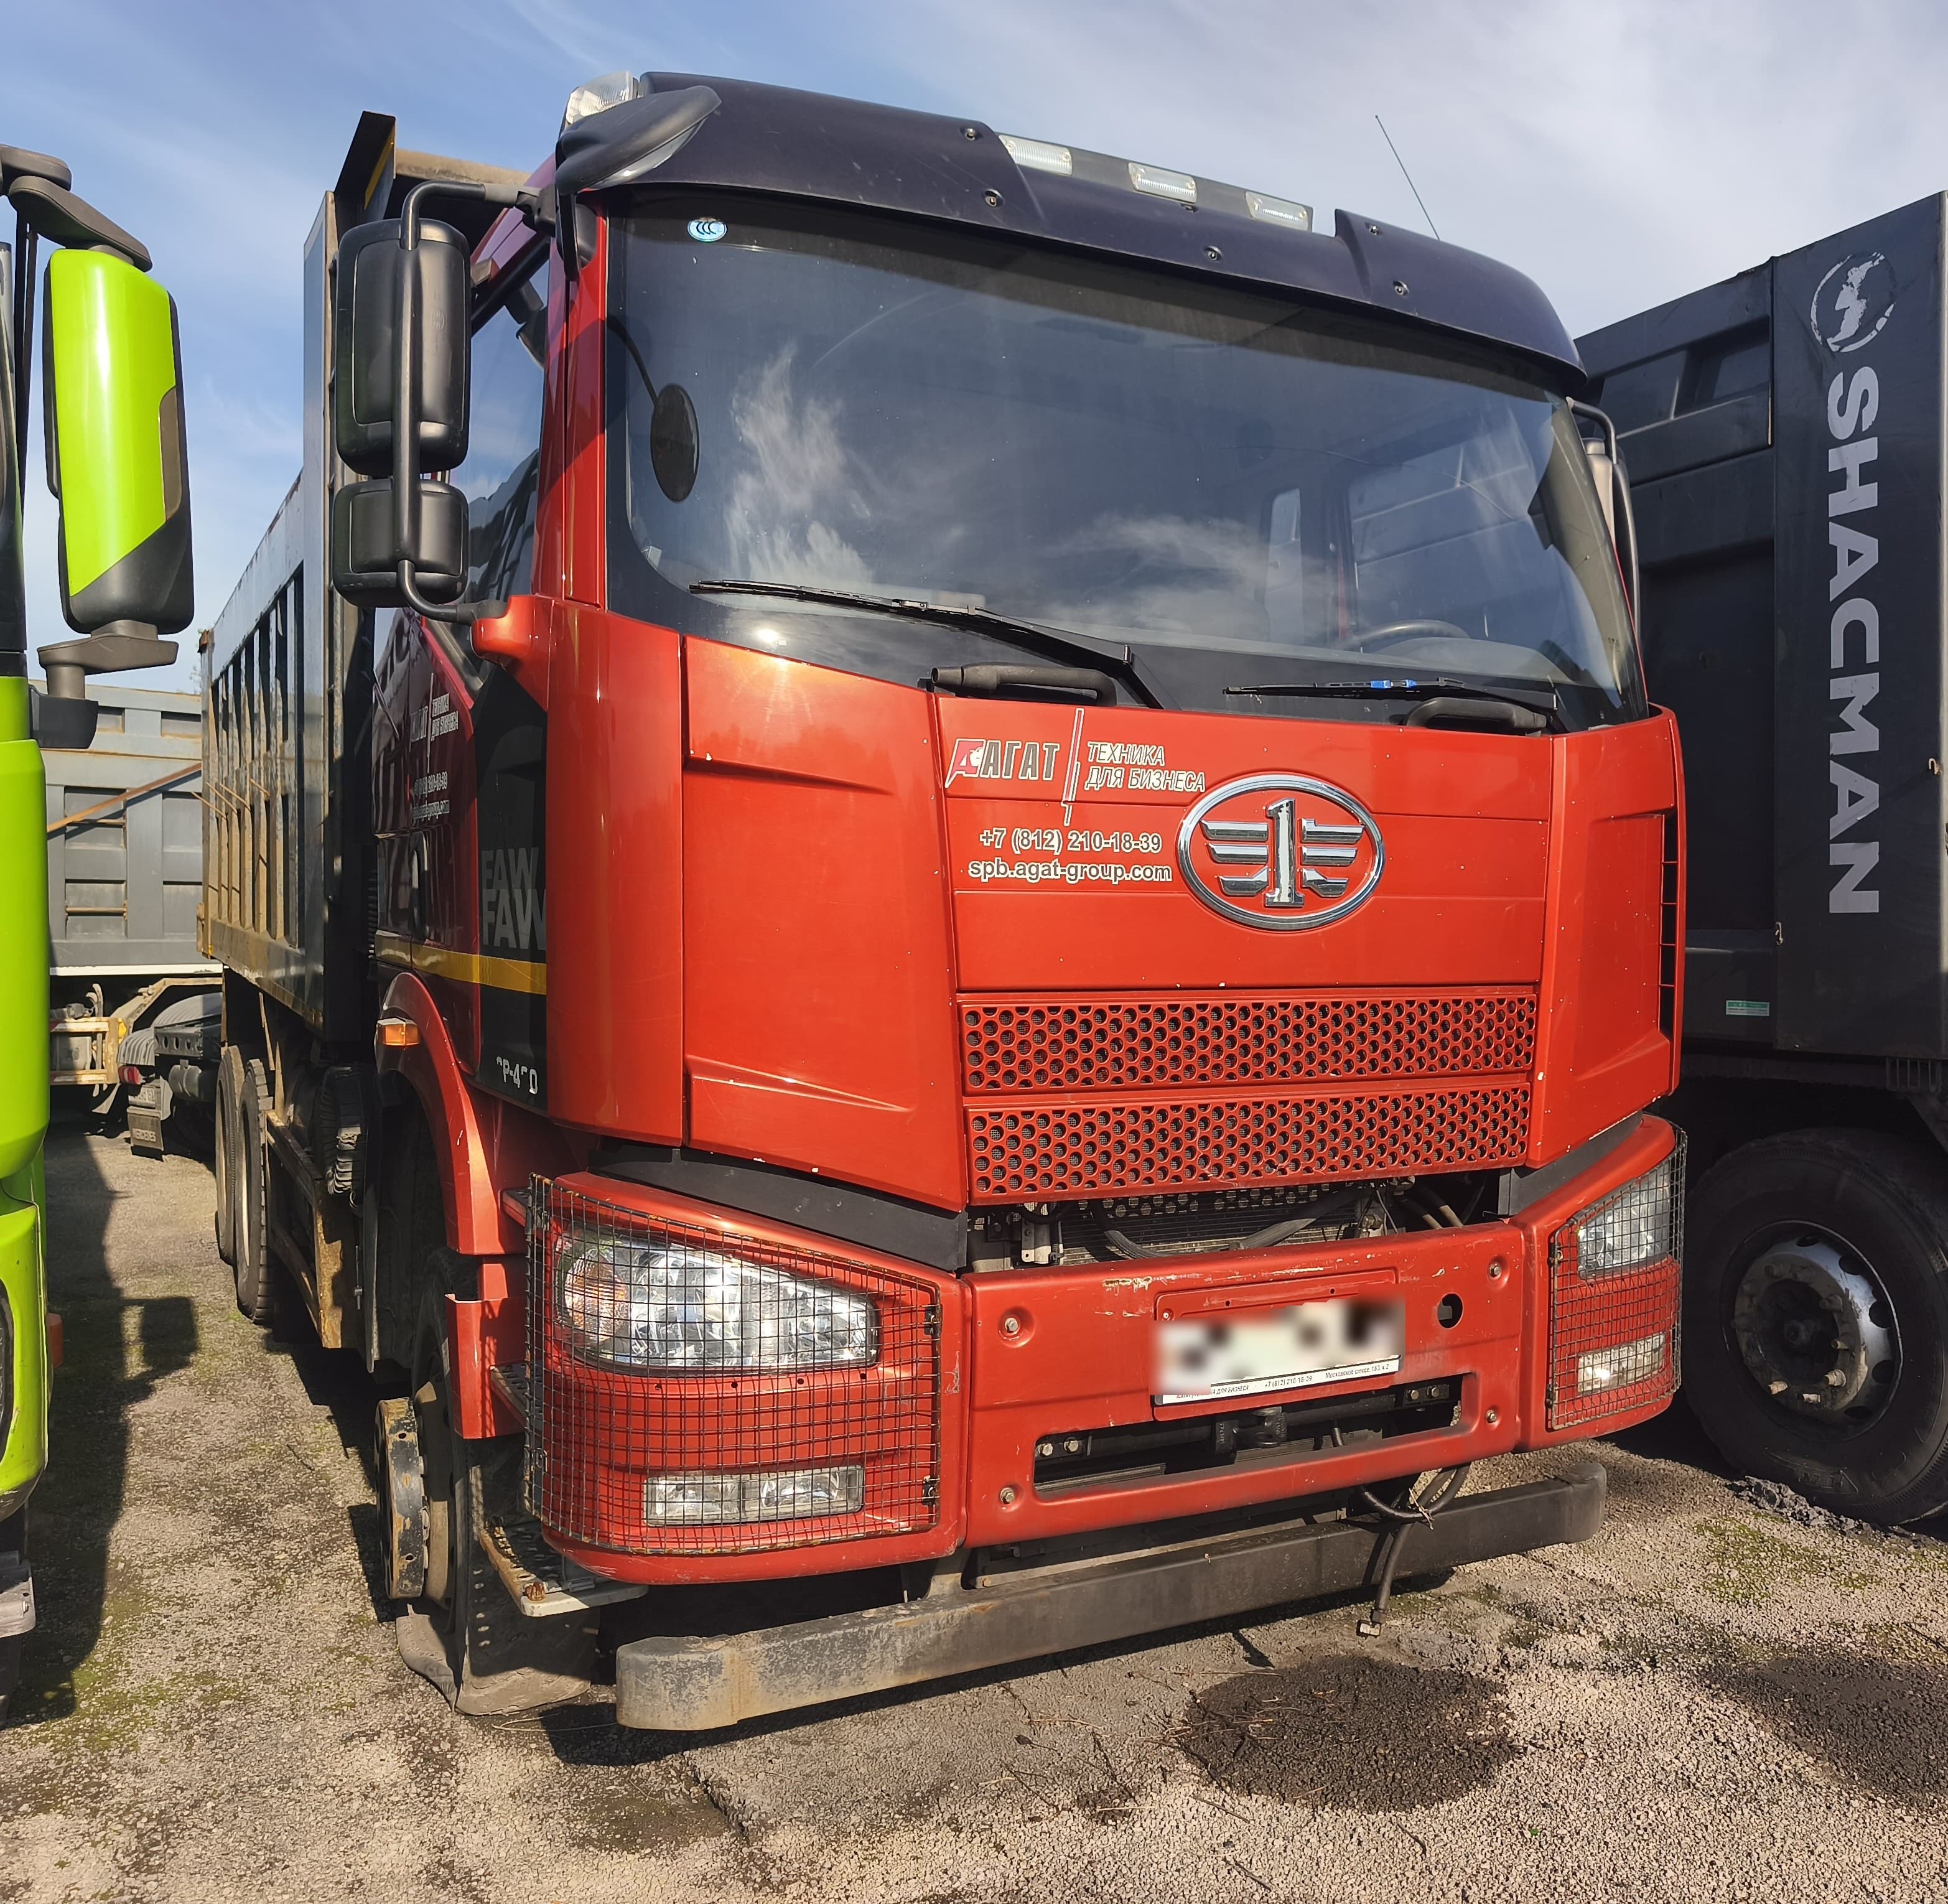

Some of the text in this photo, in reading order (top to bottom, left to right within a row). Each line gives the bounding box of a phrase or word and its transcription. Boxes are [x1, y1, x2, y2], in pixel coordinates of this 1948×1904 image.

[1827, 365, 1880, 913] SHACMAN
[979, 740, 1060, 781] АГАТ
[1087, 741, 1165, 767] ТЕХНИКА
[1084, 767, 1206, 792] ДЛЯ БИЗНЕСА
[979, 828, 1162, 854] +7 (812) 210-18-39
[482, 847, 539, 890] FAW
[969, 857, 1172, 884] spb.agat-group.com
[482, 889, 546, 950] FAW
